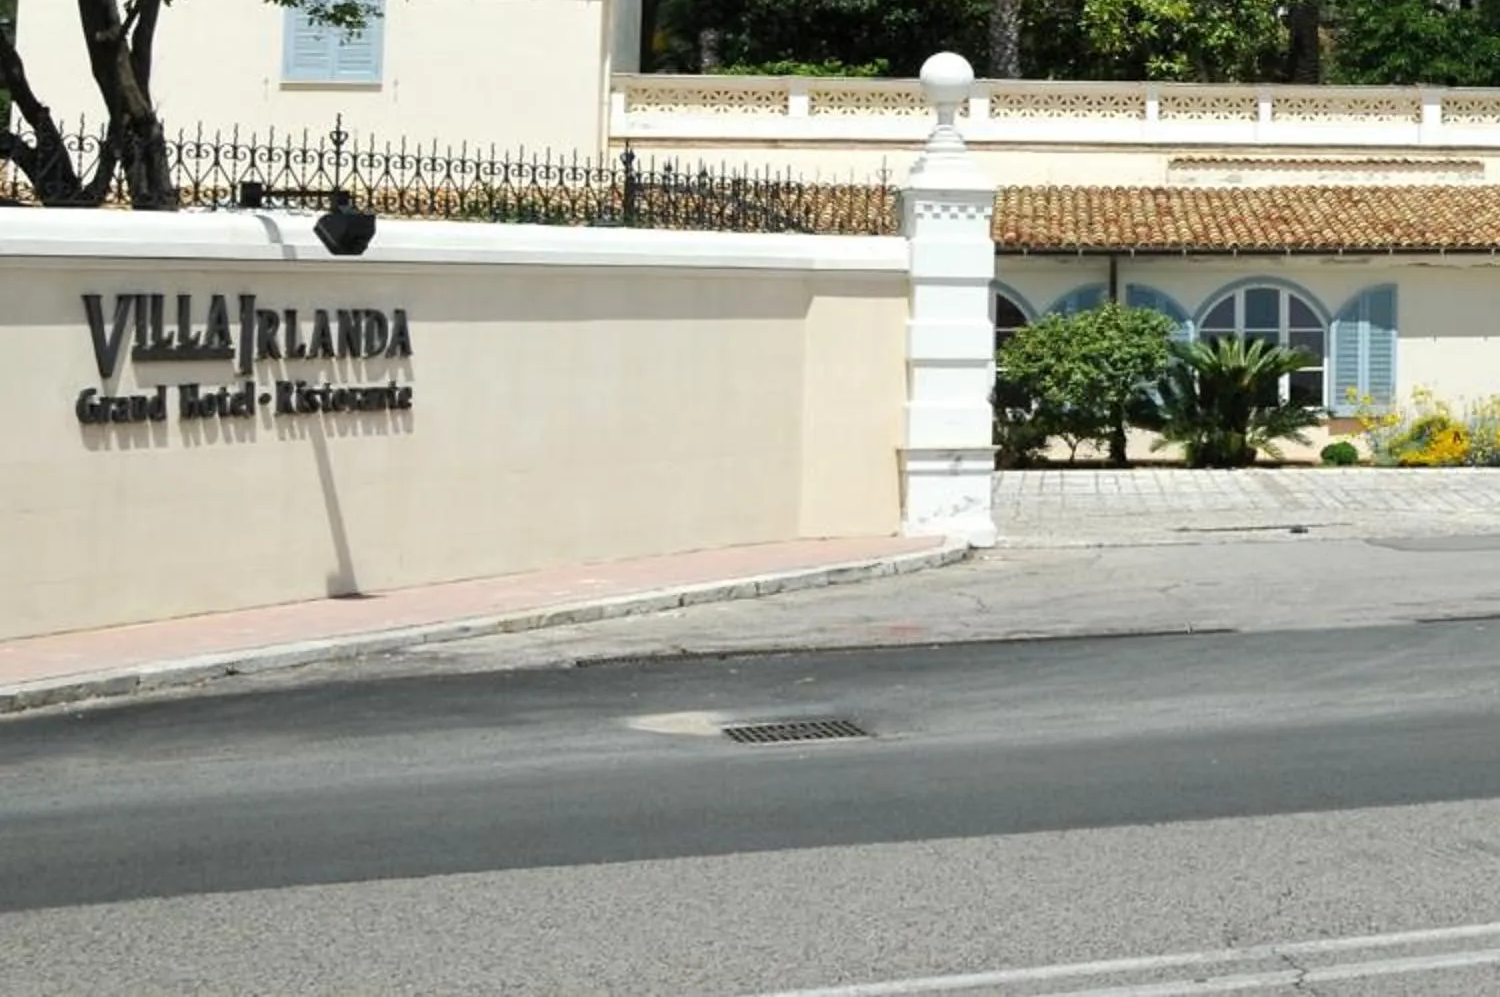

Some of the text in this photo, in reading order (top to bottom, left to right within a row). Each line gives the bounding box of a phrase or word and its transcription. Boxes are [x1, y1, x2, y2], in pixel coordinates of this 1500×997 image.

[80, 293, 413, 379] VILLA IRLANDA
[75, 379, 413, 424] Grand Hotel Ristorante
